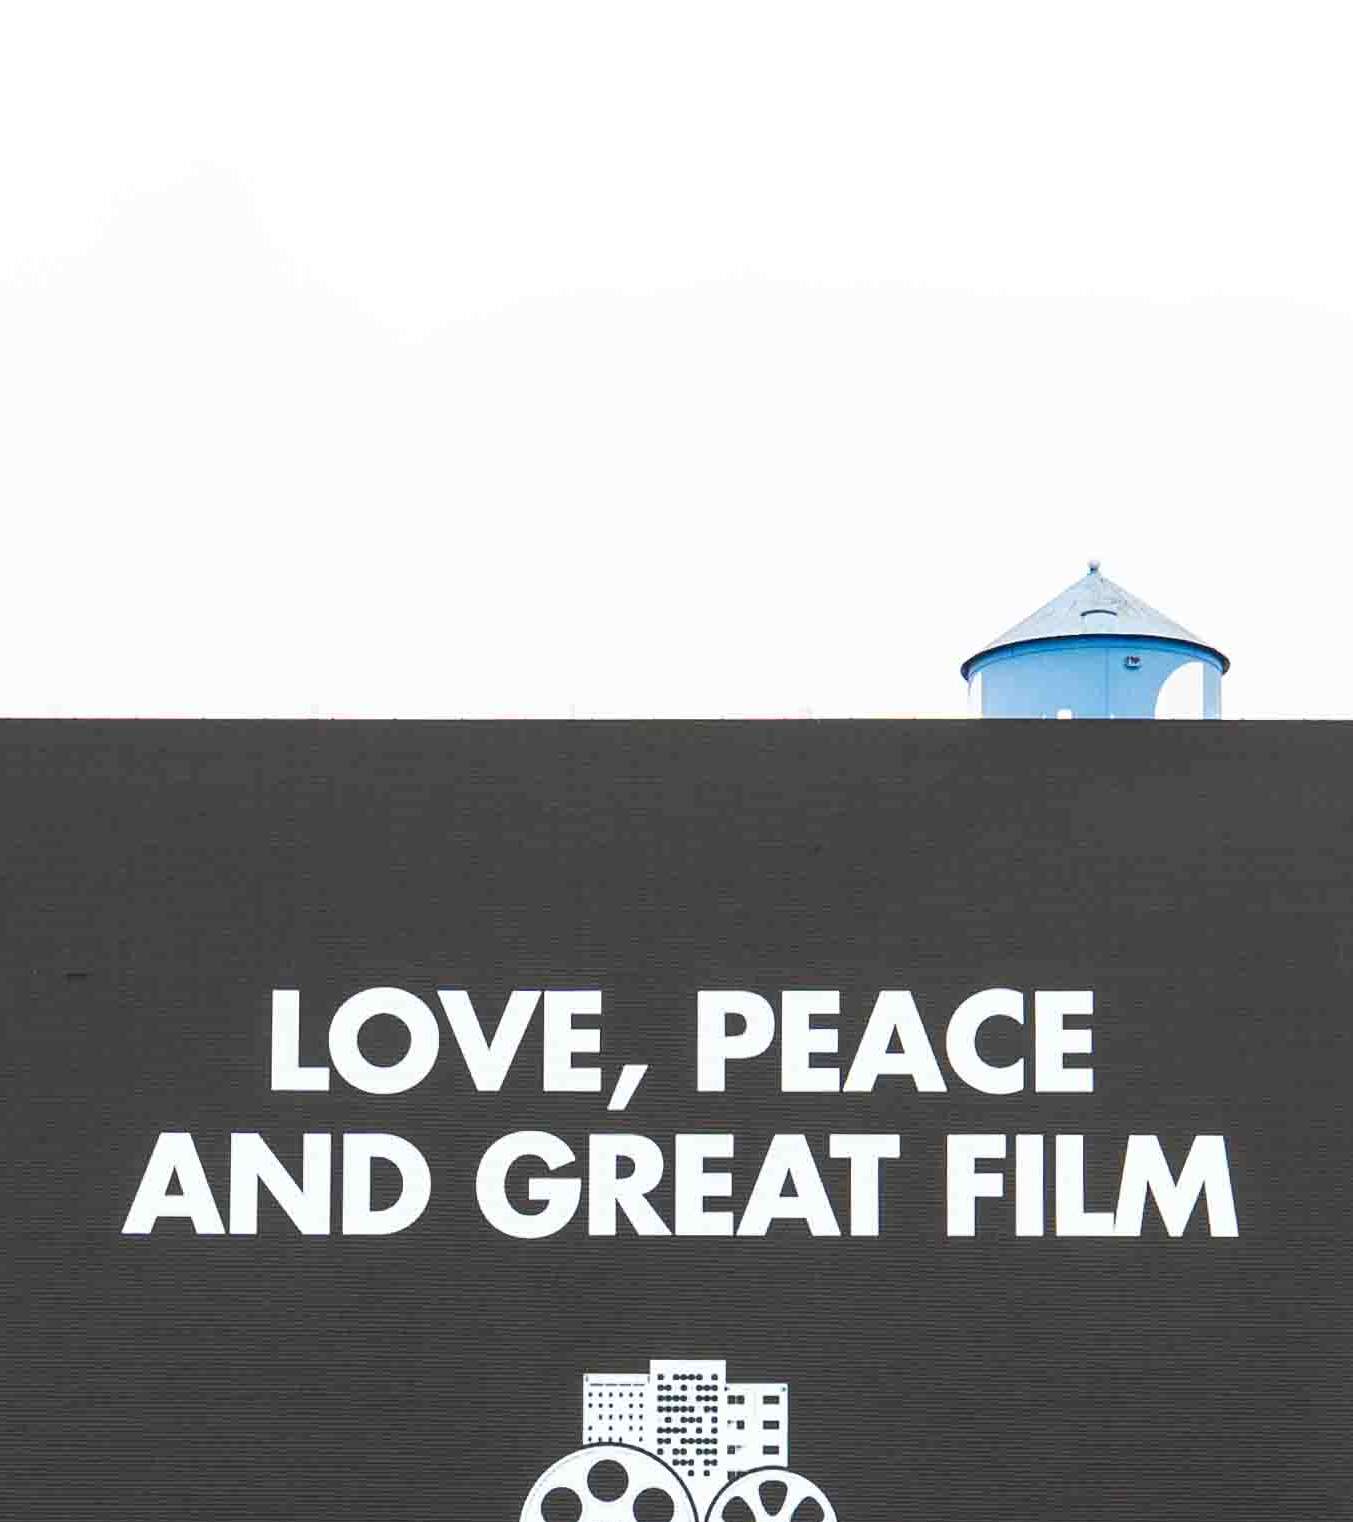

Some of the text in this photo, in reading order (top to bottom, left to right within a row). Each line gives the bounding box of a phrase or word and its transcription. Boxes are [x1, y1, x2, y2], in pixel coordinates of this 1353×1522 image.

[269, 986, 1095, 1112] LOVE, PEACE
[121, 1129, 1241, 1241] AND GREAT FILM
